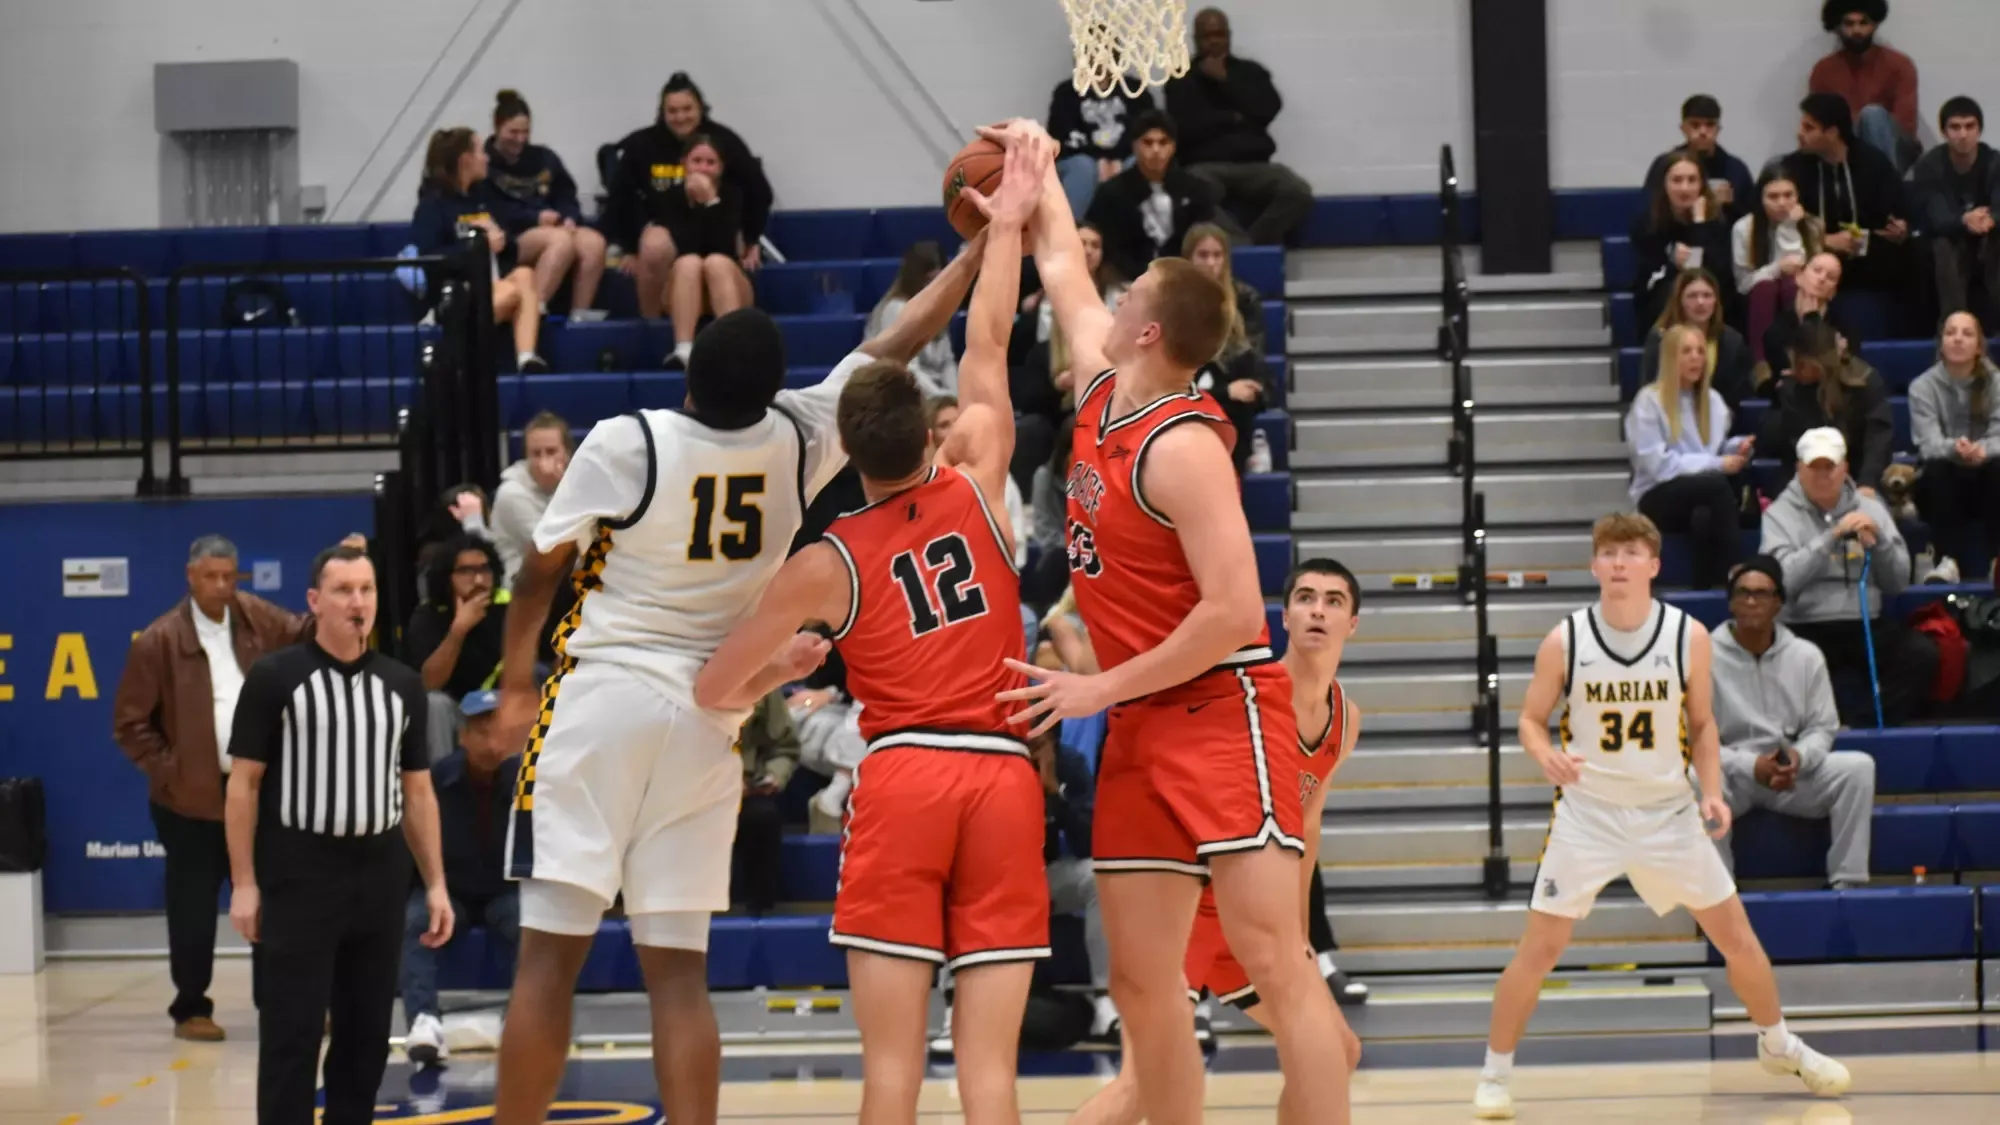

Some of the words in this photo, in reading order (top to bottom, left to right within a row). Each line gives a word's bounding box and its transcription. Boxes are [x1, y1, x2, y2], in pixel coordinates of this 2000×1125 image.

[687, 473, 767, 562] 15
[889, 531, 990, 640] 12
[1585, 680, 1669, 702] MARIAN
[1599, 709, 1656, 754] 34
[86, 841, 140, 858] Marian
